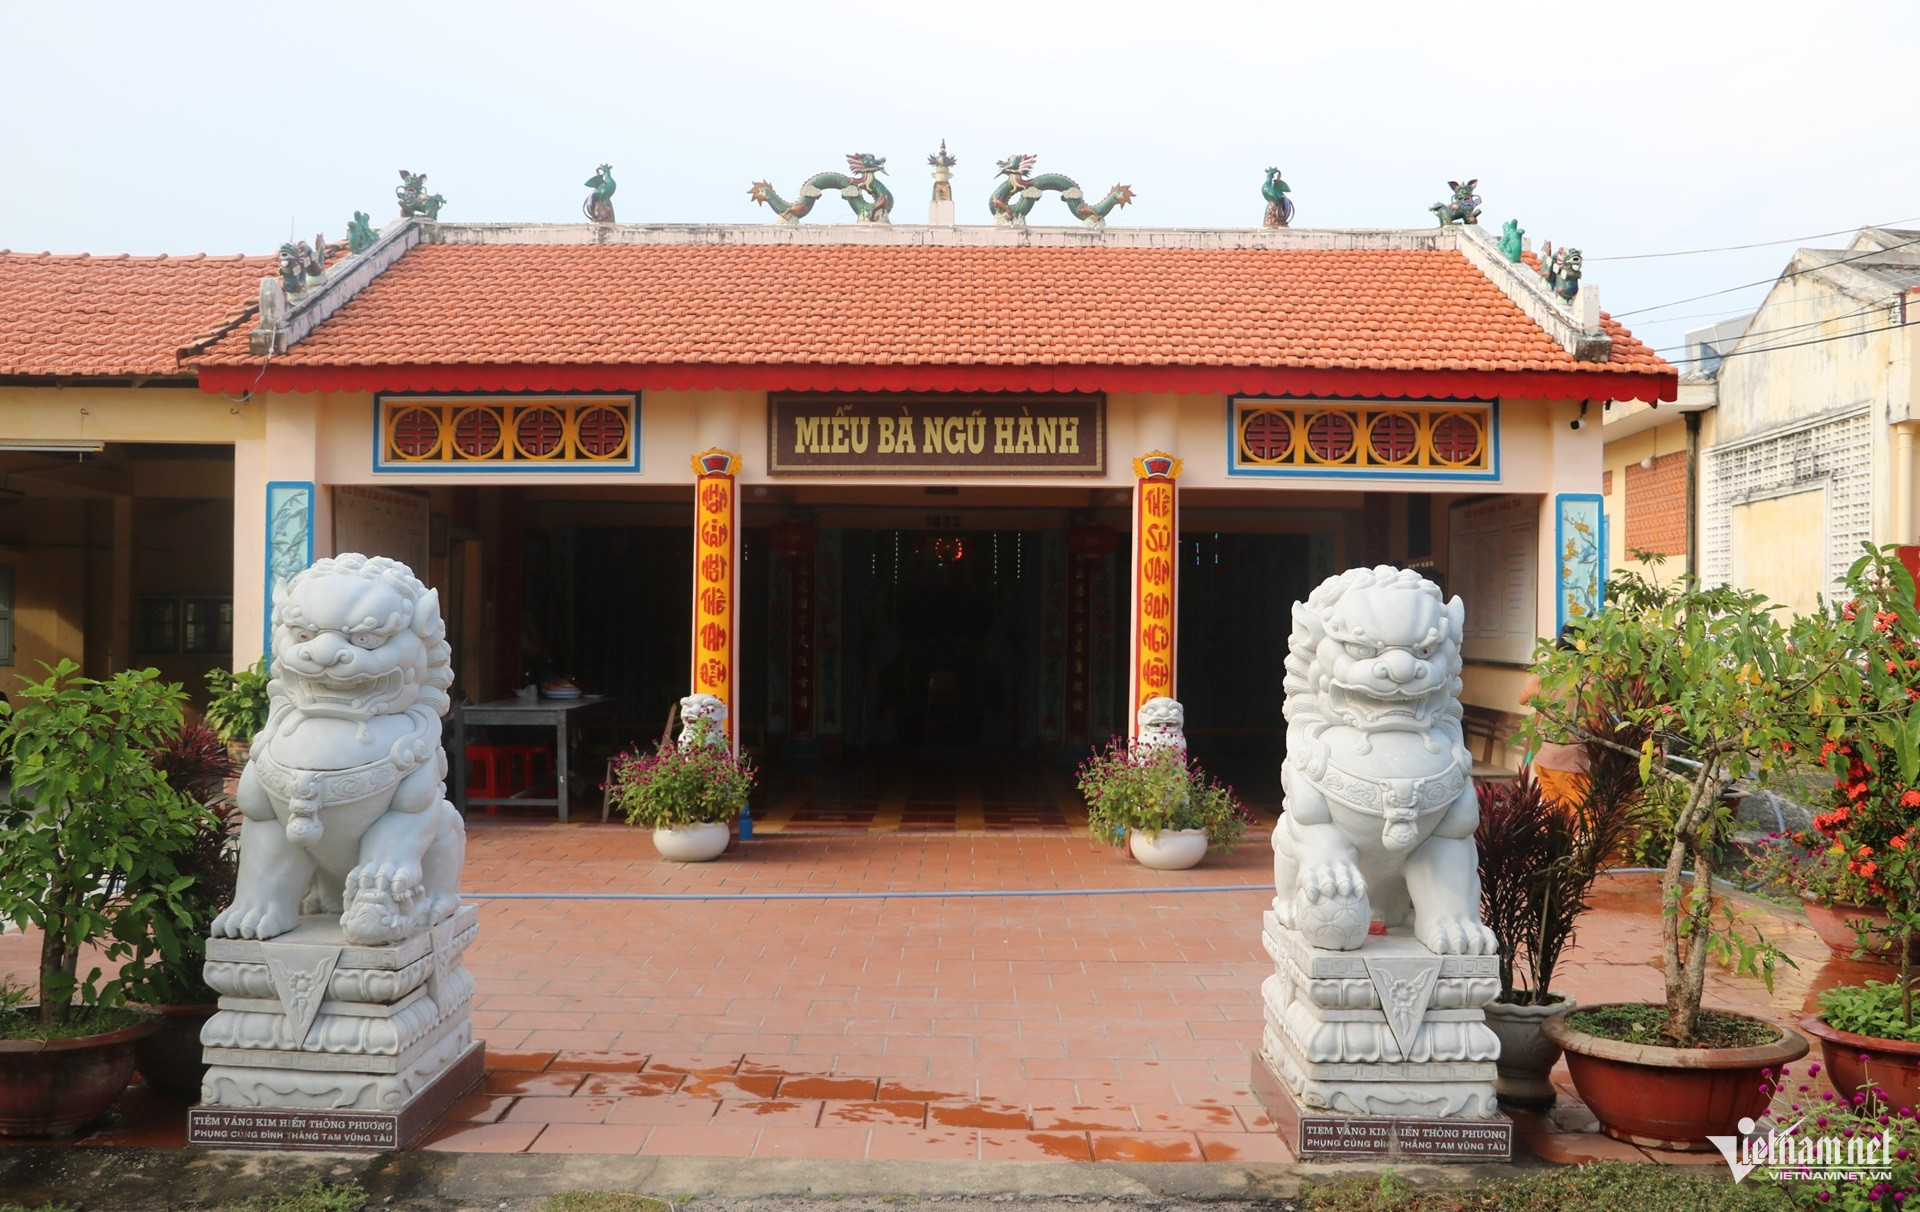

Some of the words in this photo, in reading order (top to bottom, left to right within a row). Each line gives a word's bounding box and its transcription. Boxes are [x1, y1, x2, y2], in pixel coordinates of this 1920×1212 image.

[794, 404, 871, 454] MIỄU
[877, 406, 916, 454] BÀ
[922, 408, 987, 454] NGŨ
[993, 406, 1080, 454] HÀNH
[1145, 523, 1171, 552] SỰ
[1143, 592, 1170, 619] BAN
[699, 621, 727, 652] TAM
[255, 1118, 278, 1127] KIM
[321, 1132, 342, 1142] TAM
[1434, 1141, 1455, 1150] TAM
